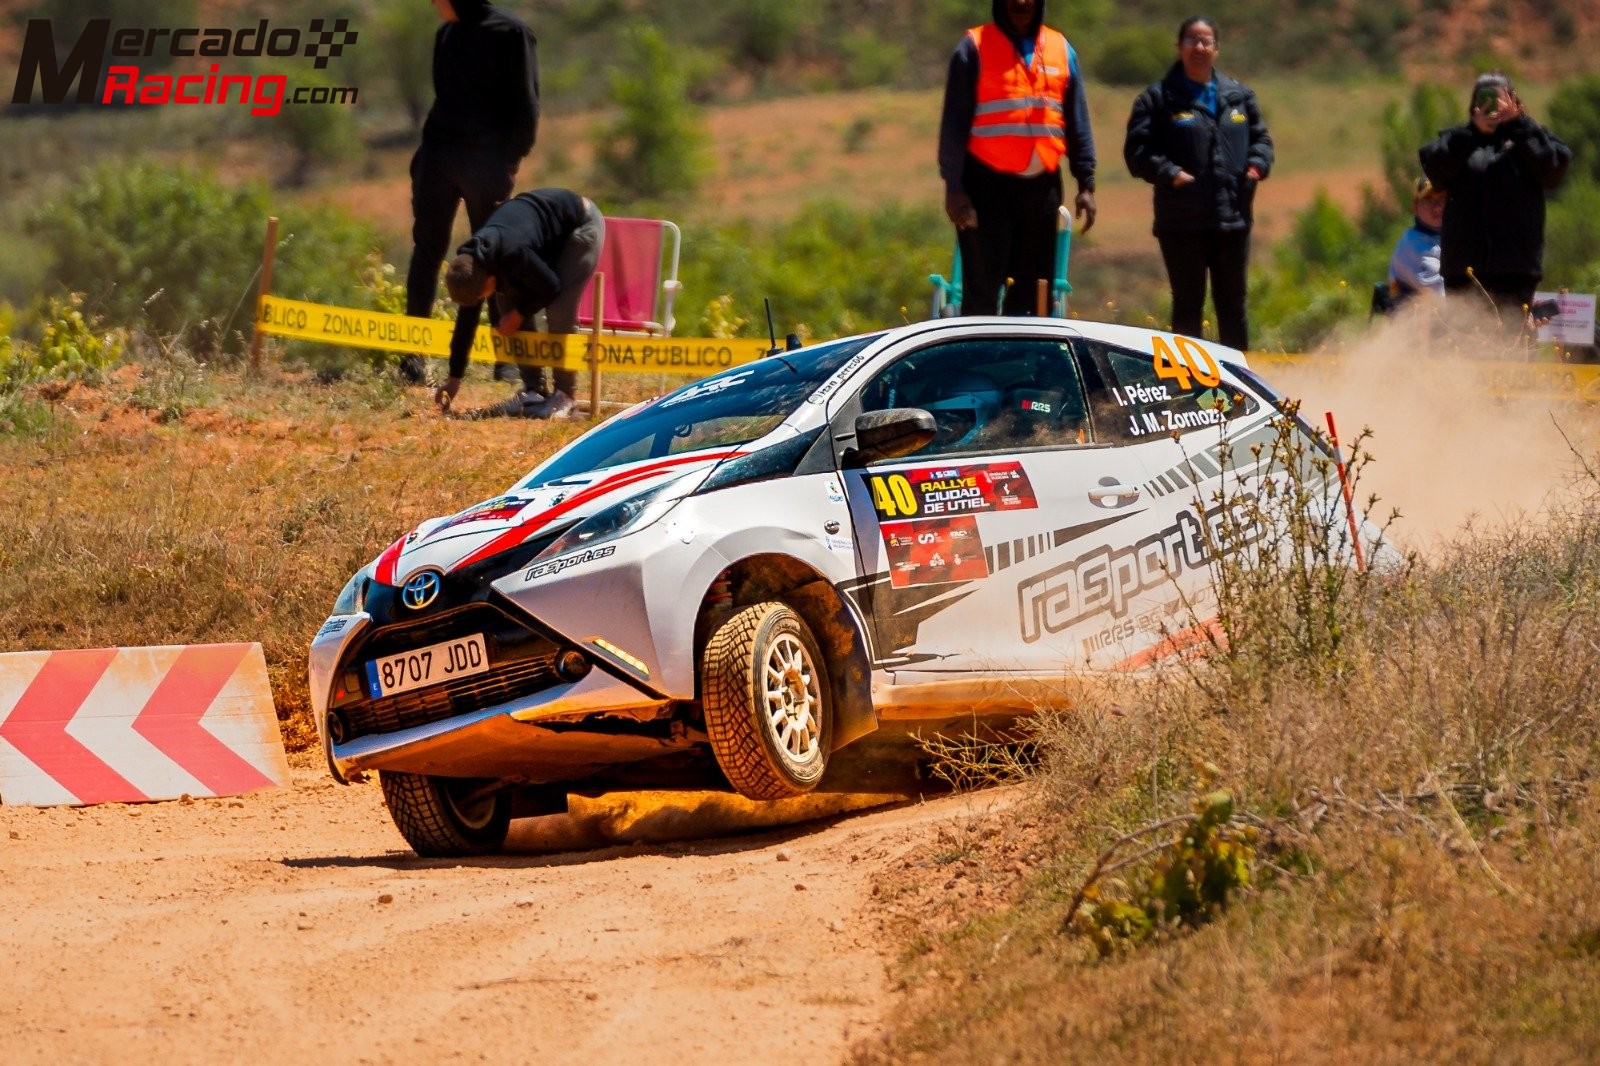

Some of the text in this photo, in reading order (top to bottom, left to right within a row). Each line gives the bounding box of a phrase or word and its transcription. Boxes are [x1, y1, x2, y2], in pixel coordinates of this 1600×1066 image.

[322, 313, 433, 346] ZONA PUBLICO
[493, 335, 564, 360] PUBLICO
[642, 345, 732, 367] PUBLICO
[1151, 335, 1221, 390] 40
[1112, 383, 1172, 407] I. Pérez
[1129, 415, 1145, 436] J.
[1141, 412, 1166, 434] M.
[870, 474, 919, 517] 40
[920, 477, 977, 492] RALLYE
[925, 487, 981, 502] CIUDAD
[924, 503, 945, 514] DE
[947, 497, 991, 513] UTIEL
[525, 546, 616, 581] rasport.es
[382, 640, 482, 689] 8707 JDD
[373, 683, 379, 691] E
